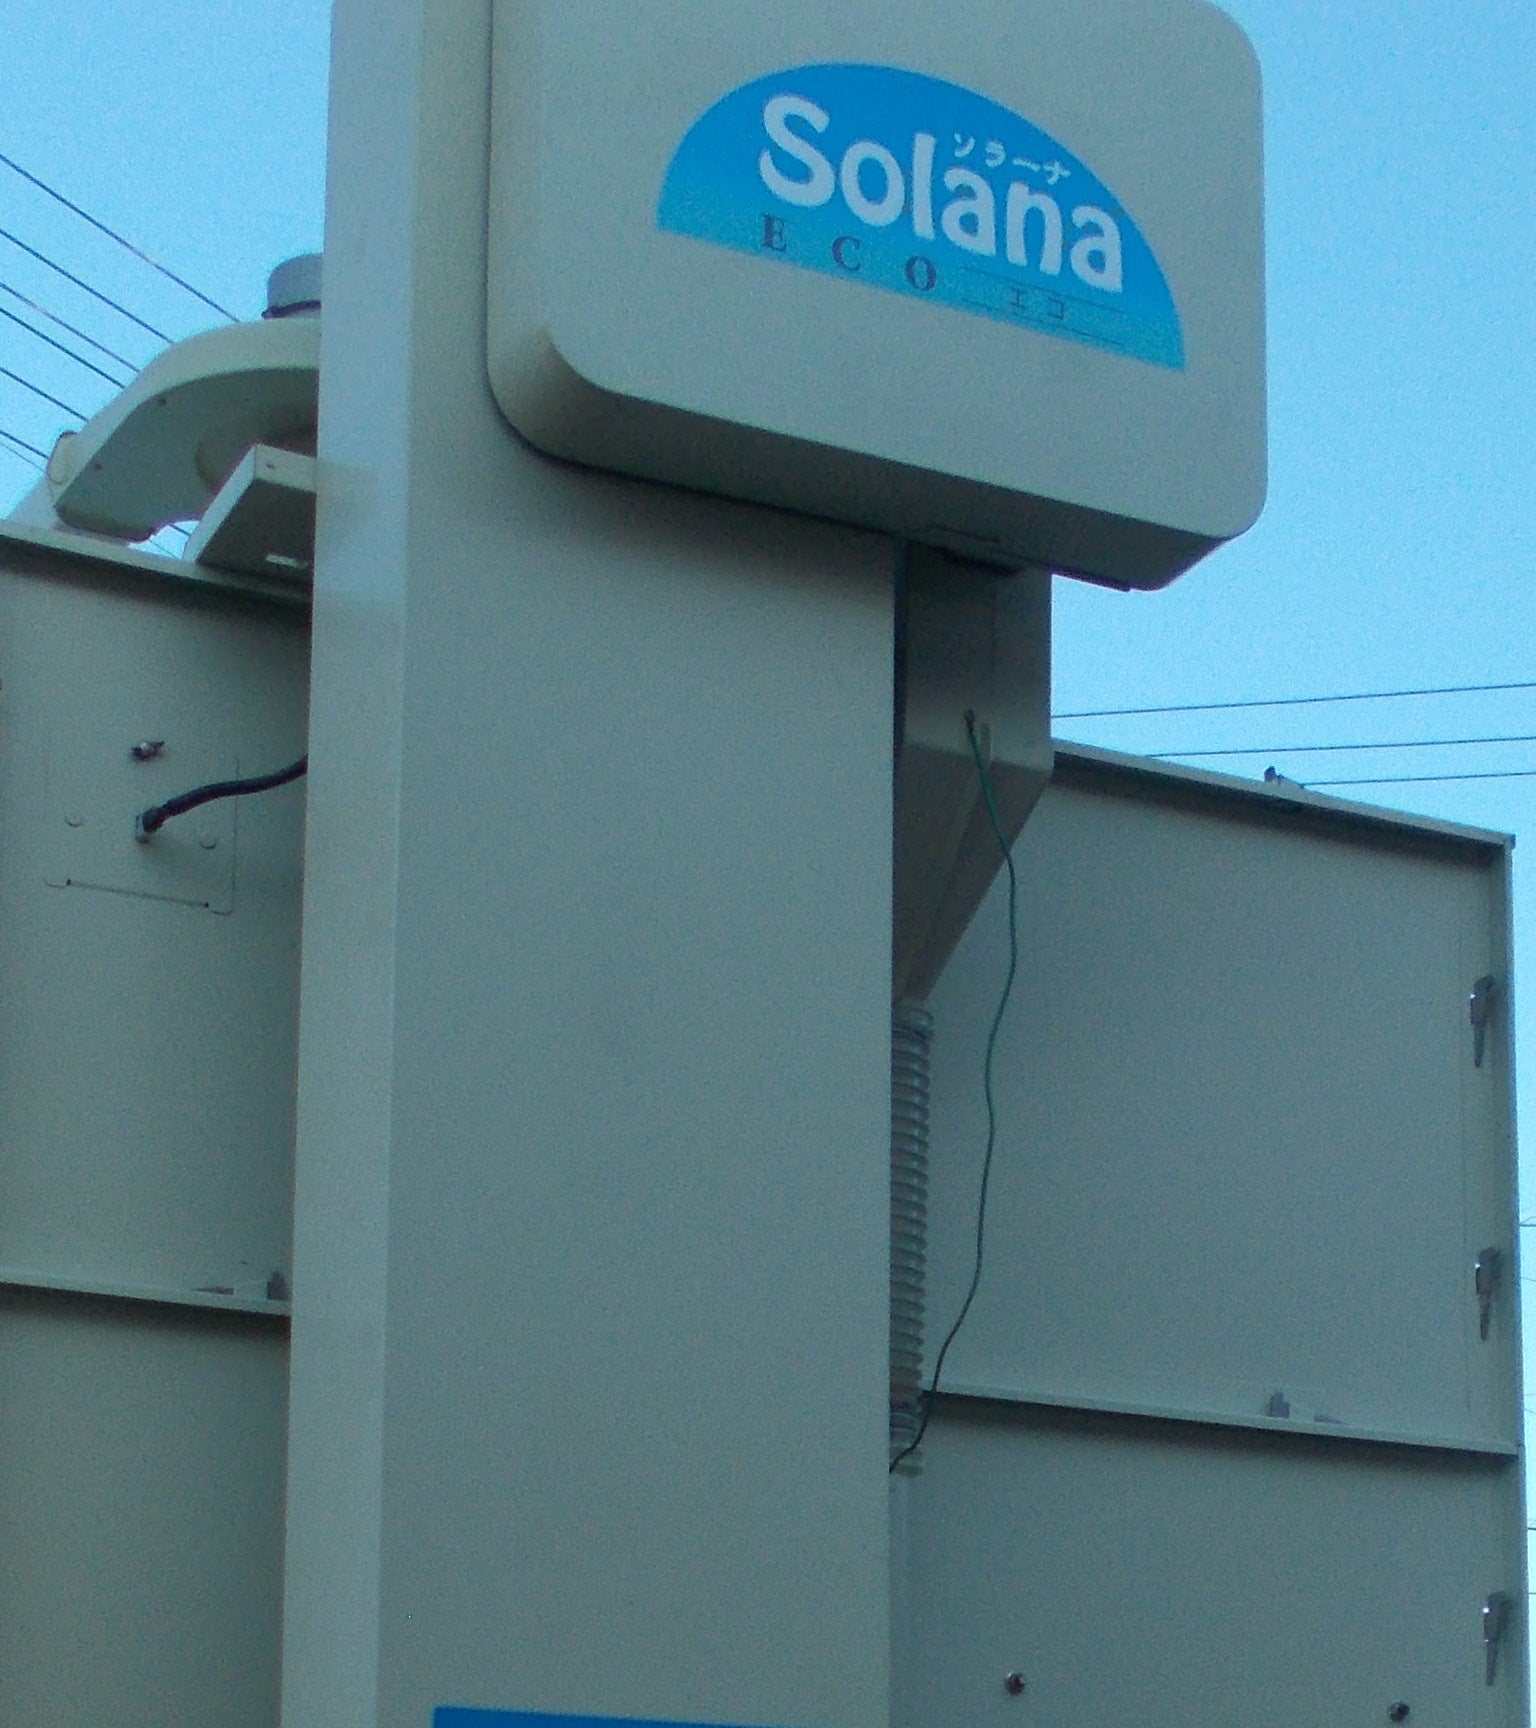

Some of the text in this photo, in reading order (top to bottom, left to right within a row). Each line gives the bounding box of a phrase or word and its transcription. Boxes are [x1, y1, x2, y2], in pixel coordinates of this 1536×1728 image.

[759, 92, 1124, 294] Solana
[952, 131, 1072, 186] ソラーナ
[760, 213, 938, 293] ECO
